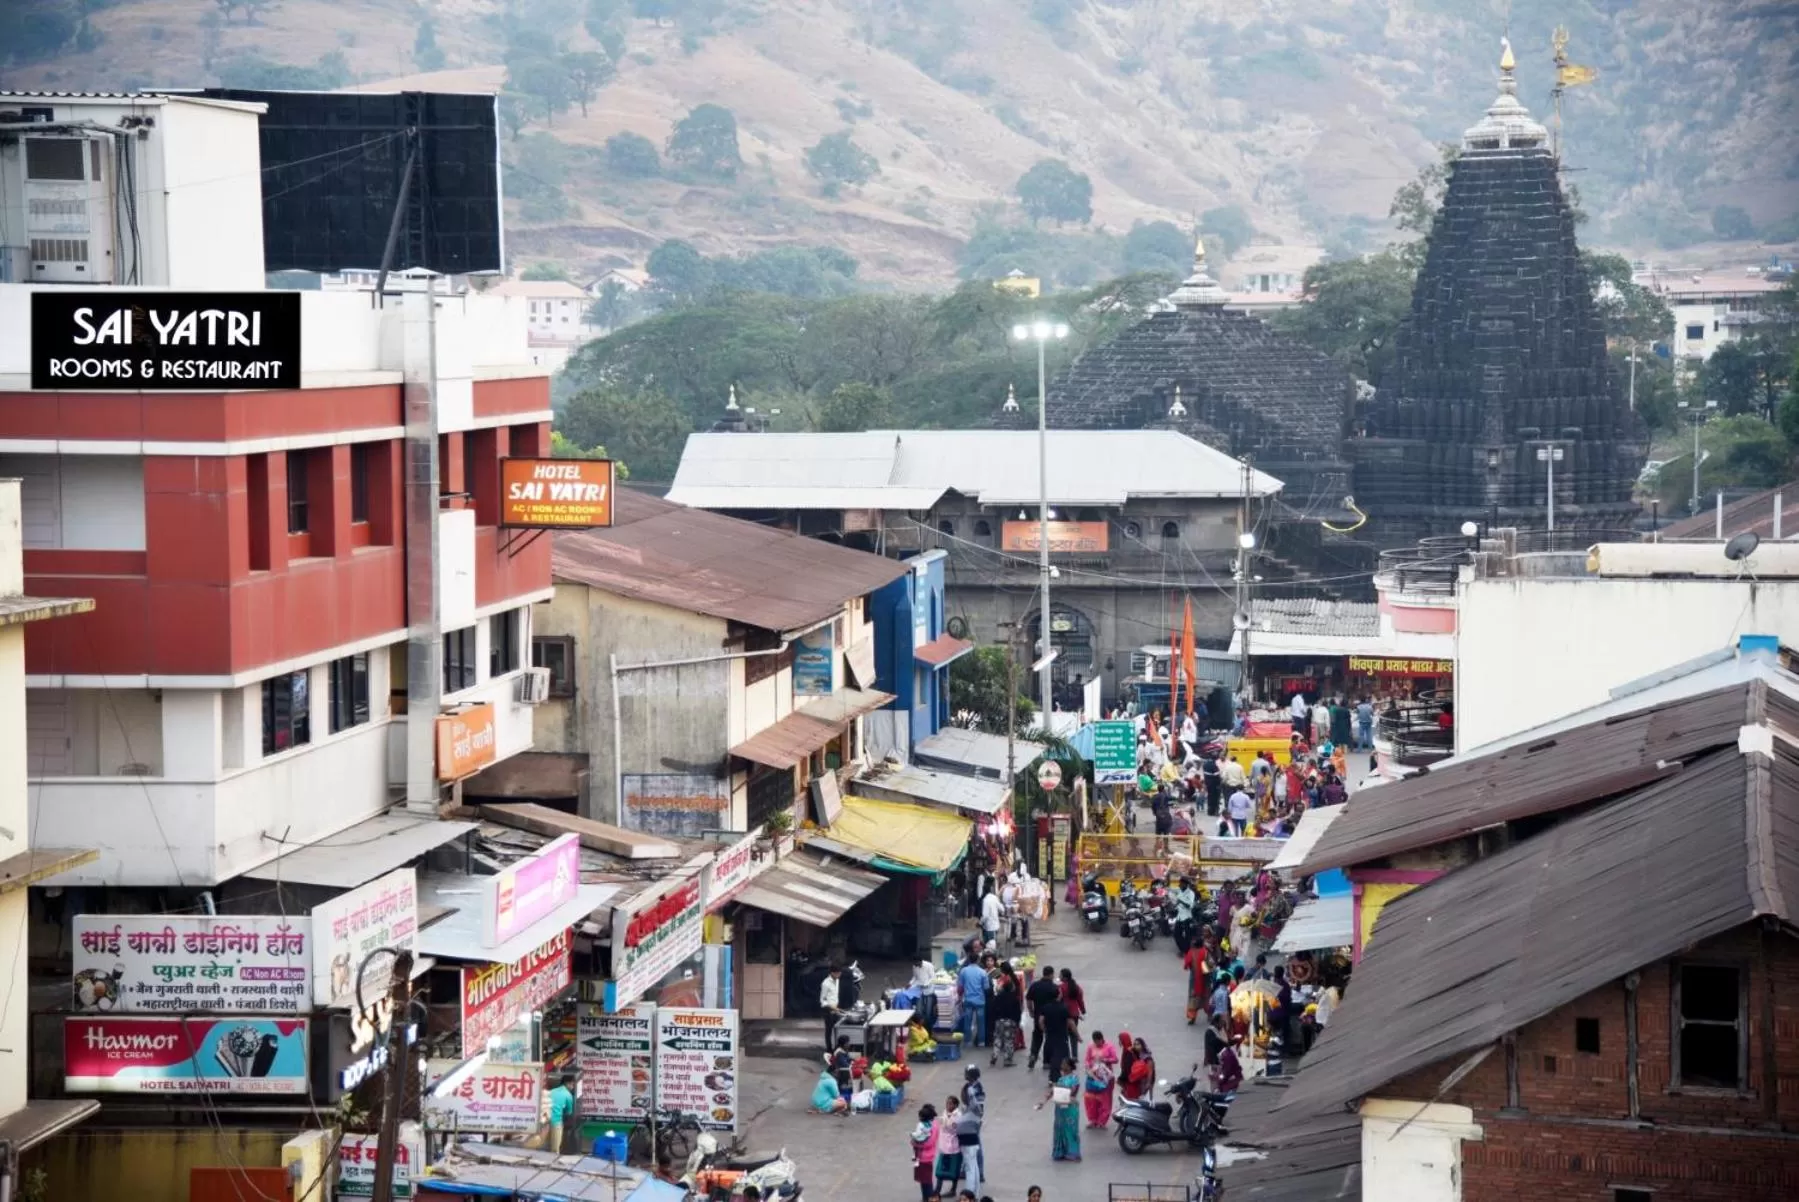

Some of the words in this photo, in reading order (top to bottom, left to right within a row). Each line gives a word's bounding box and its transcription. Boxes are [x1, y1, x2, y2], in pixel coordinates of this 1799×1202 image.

[73, 307, 132, 345] SAI
[149, 309, 260, 347] YATRI
[50, 358, 132, 378] ROOMS
[140, 359, 154, 378] &
[162, 360, 282, 379] RESTAURANT
[534, 465, 581, 479] HOTEL
[508, 482, 544, 500] SAI
[549, 483, 606, 501] YATRI
[512, 504, 525, 513] AC
[554, 505, 567, 514] AC
[568, 505, 603, 514] ROOMS
[531, 514, 592, 523] RESTAURANT
[81, 924, 122, 957] साई
[183, 925, 260, 958] डाईनिंग
[266, 924, 304, 956] हॉल
[152, 964, 195, 982] प्युअर
[200, 961, 234, 979] व्हेज
[241, 969, 252, 978] AC
[254, 969, 269, 978] Non
[270, 969, 284, 979] AC
[155, 983, 193, 997] गुजराती
[83, 1026, 178, 1050] Havmor
[662, 1022, 732, 1039] भोजनालय
[107, 1051, 121, 1059] ICE
[124, 1051, 153, 1059] CREAM
[140, 1081, 175, 1090] HOTEL
[178, 1081, 198, 1090] SAI
[199, 1081, 230, 1090] YATRI
[482, 1071, 535, 1100] यात्री
